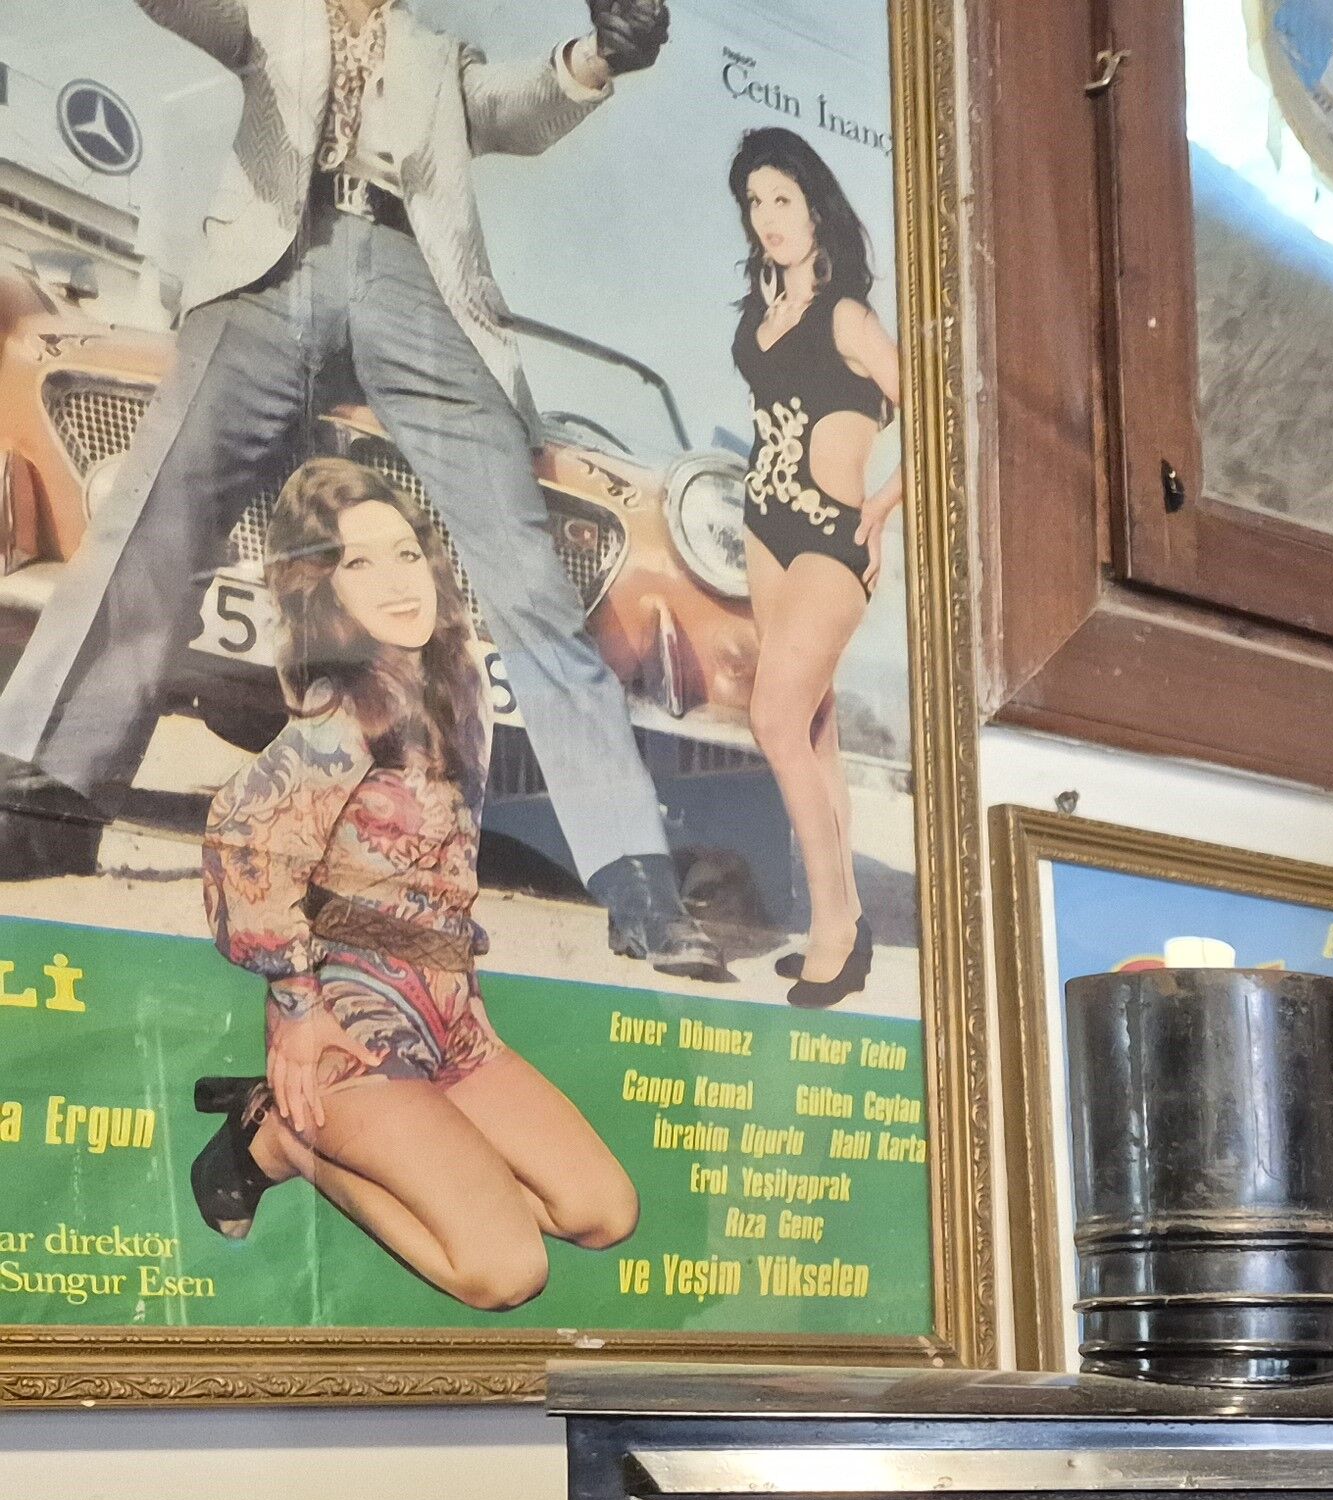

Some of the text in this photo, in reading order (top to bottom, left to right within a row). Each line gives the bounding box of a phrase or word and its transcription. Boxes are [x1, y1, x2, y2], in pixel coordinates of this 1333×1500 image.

[722, 62, 800, 119] Çetin
[610, 1011, 753, 1057] Enver Dönmez
[789, 1030, 907, 1071] Türker Tekin
[622, 1069, 754, 1111] Cango Kemal
[795, 1084, 921, 1126] Gülten Ceylan
[45, 1095, 156, 1154] Ergun
[653, 1113, 730, 1152] İbrahim
[830, 1129, 871, 1160] Halil
[690, 1163, 851, 1205] Erol Yeşilyaprak
[44, 1223, 179, 1259] direktör
[725, 1207, 825, 1244] Rıza Genç
[0, 1260, 217, 1305] Sungur Esen
[619, 1254, 870, 1303] ve Yeşim Yükselen
